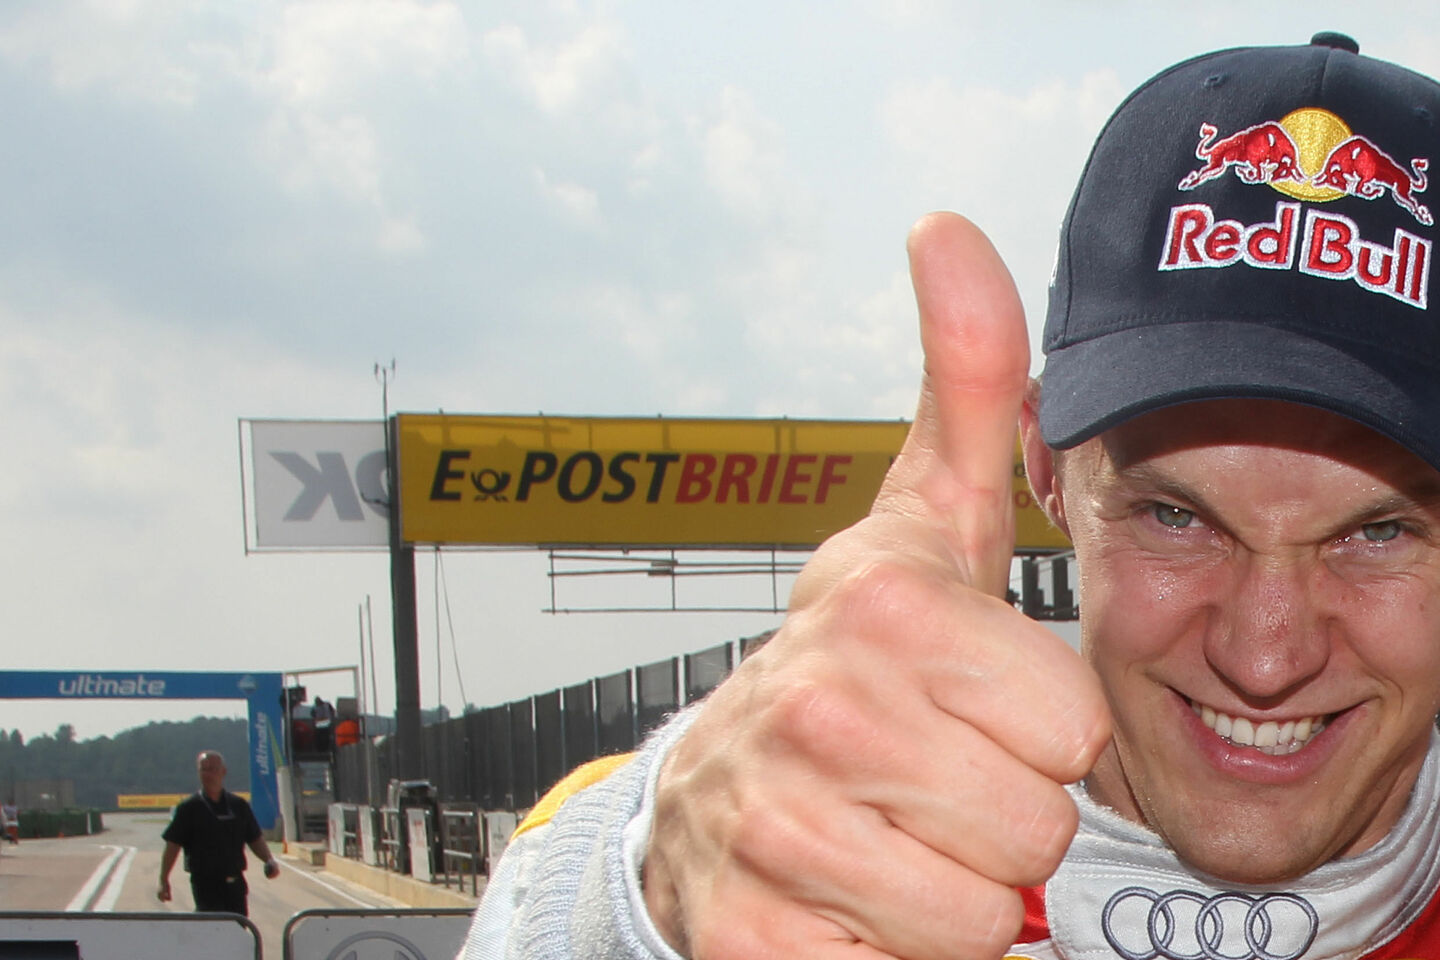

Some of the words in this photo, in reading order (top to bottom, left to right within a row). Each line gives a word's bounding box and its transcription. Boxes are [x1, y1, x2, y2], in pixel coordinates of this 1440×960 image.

[1163, 205, 1296, 267] Red
[1305, 216, 1428, 303] Bull
[58, 675, 166, 696] ultimate
[255, 711, 268, 775] ultimate
